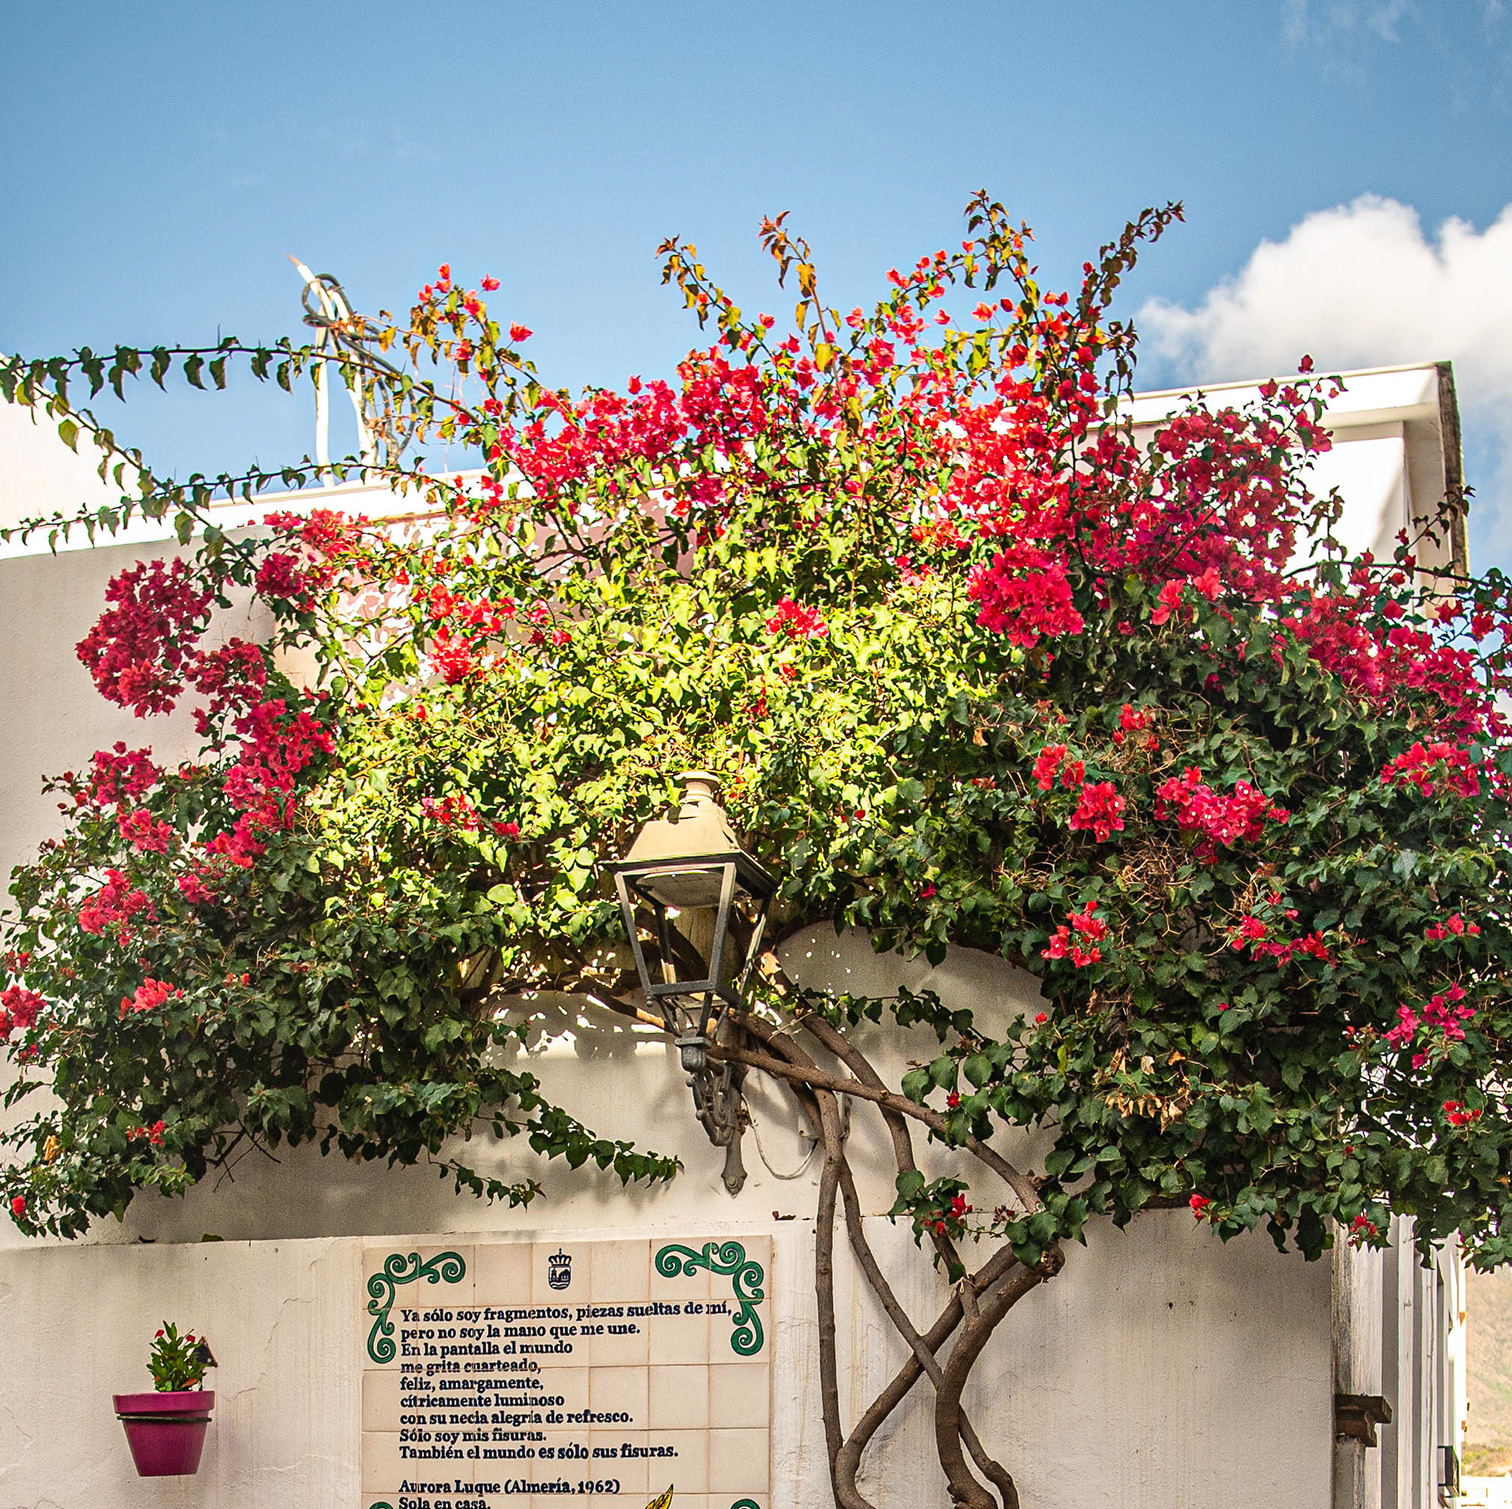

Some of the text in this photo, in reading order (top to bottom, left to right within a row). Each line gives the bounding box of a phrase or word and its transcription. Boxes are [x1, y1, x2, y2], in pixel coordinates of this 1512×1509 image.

[400, 1301, 732, 1323] Ya sólo soy fragmentos, piezas sueltas de mí,
[400, 1323, 640, 1342] pero no soy la mano que me une.
[401, 1340, 573, 1358] En la pantalla el mundo
[400, 1358, 542, 1376] me grita cuarteado,
[400, 1376, 544, 1393] feliz, amargamente,
[400, 1392, 564, 1408] cítricamente luminoso
[400, 1409, 633, 1426] con su necia alegría de refresco.
[400, 1428, 546, 1445] Sólo soy mis fisuras.
[399, 1442, 679, 1459] También el mundo es sólo sus fisuras.
[399, 1480, 452, 1493] Aurora
[454, 1479, 501, 1497] Luque
[399, 1497, 490, 1509] Sola en casa.
